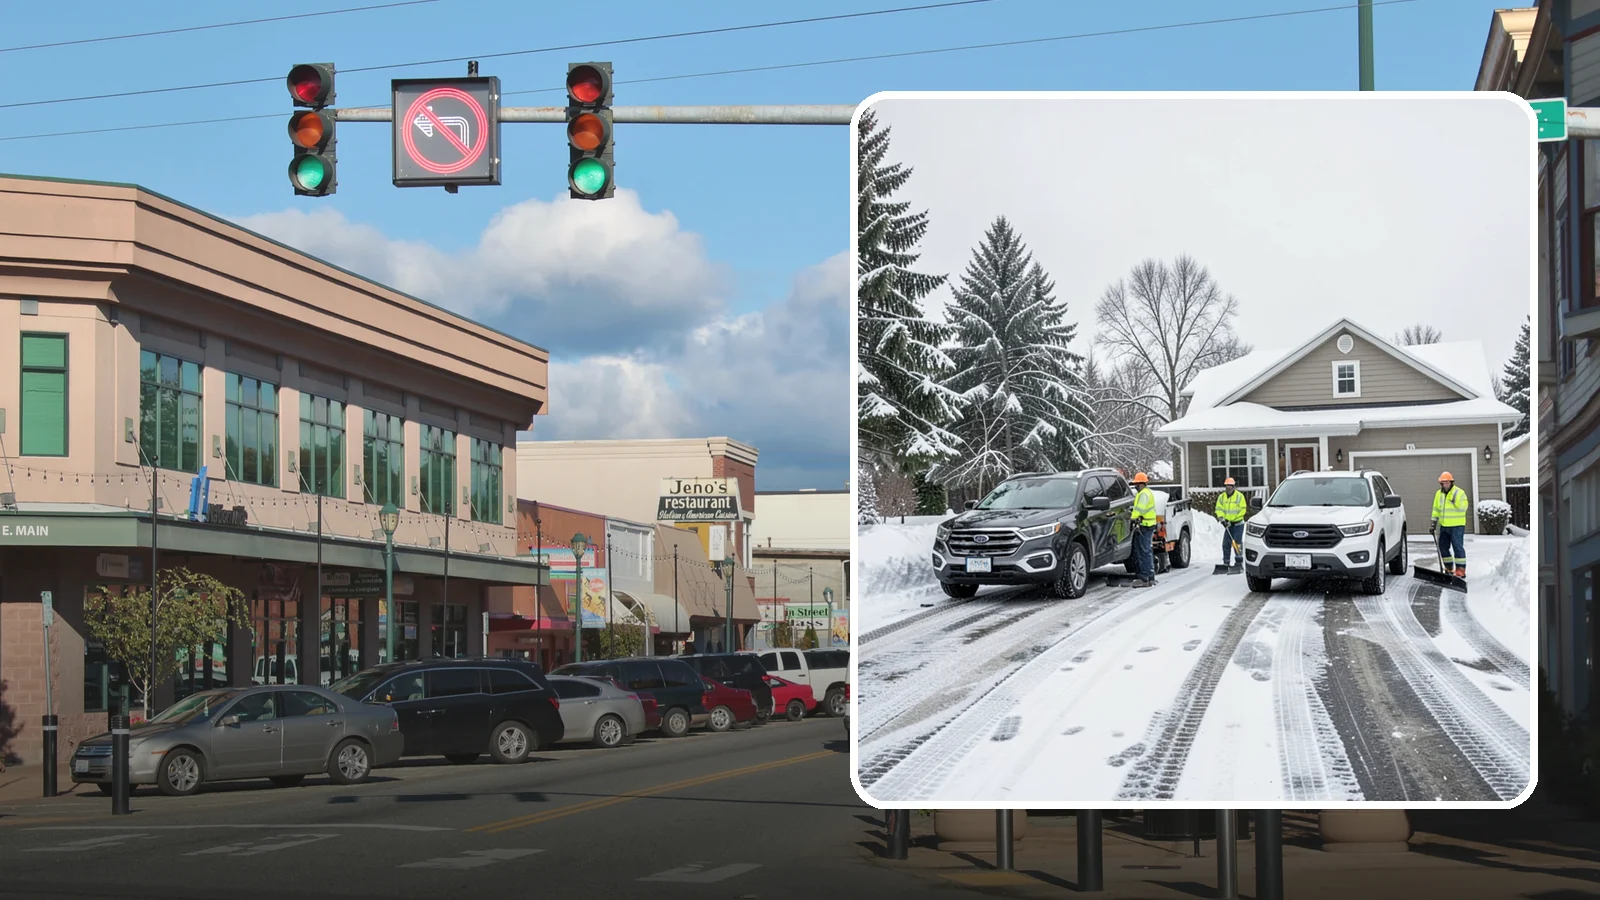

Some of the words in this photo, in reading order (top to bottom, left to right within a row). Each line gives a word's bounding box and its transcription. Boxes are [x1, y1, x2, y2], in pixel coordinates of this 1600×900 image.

[669, 480, 728, 495] Jeno's
[664, 496, 731, 509] restaurant
[658, 510, 681, 519] Italian
[686, 509, 715, 519] American
[715, 509, 737, 519] Cuisine
[2, 525, 13, 536] E.
[15, 525, 49, 536] MAIN
[797, 607, 828, 617] Street
